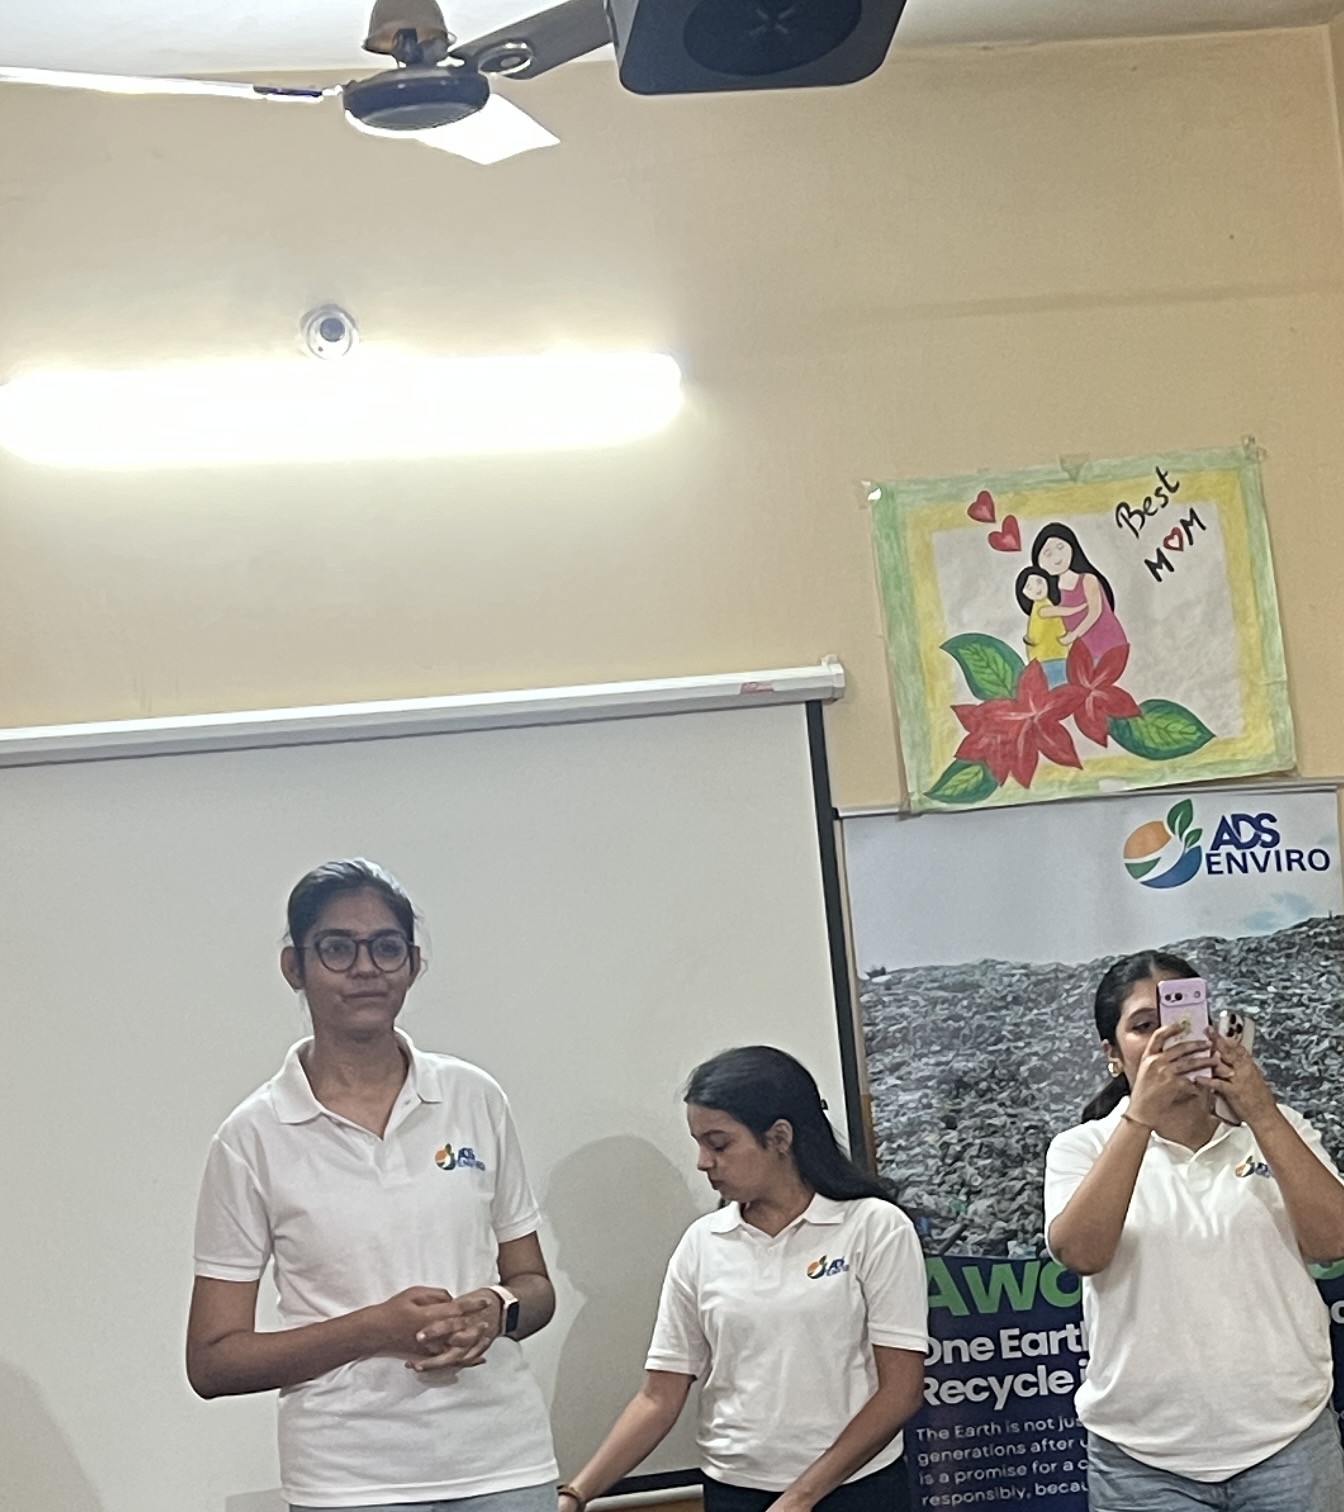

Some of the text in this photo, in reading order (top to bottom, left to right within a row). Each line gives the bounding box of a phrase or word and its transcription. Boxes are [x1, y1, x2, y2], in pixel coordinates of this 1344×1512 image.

[1115, 466, 1180, 538] Best
[1211, 812, 1281, 851] ADS
[1205, 848, 1331, 875] ENVIRO
[916, 1427, 950, 1442] The
[954, 1421, 1002, 1439] Earth
[1006, 1419, 1021, 1434] is
[1023, 1417, 1056, 1432] not
[917, 1443, 1027, 1467] generations
[1030, 1437, 1075, 1454] after
[939, 1471, 950, 1484] a
[954, 1464, 1028, 1485] promise
[1031, 1459, 1059, 1474] for
[1062, 1459, 1074, 1472] a
[921, 1485, 1032, 1507] responsibly,
